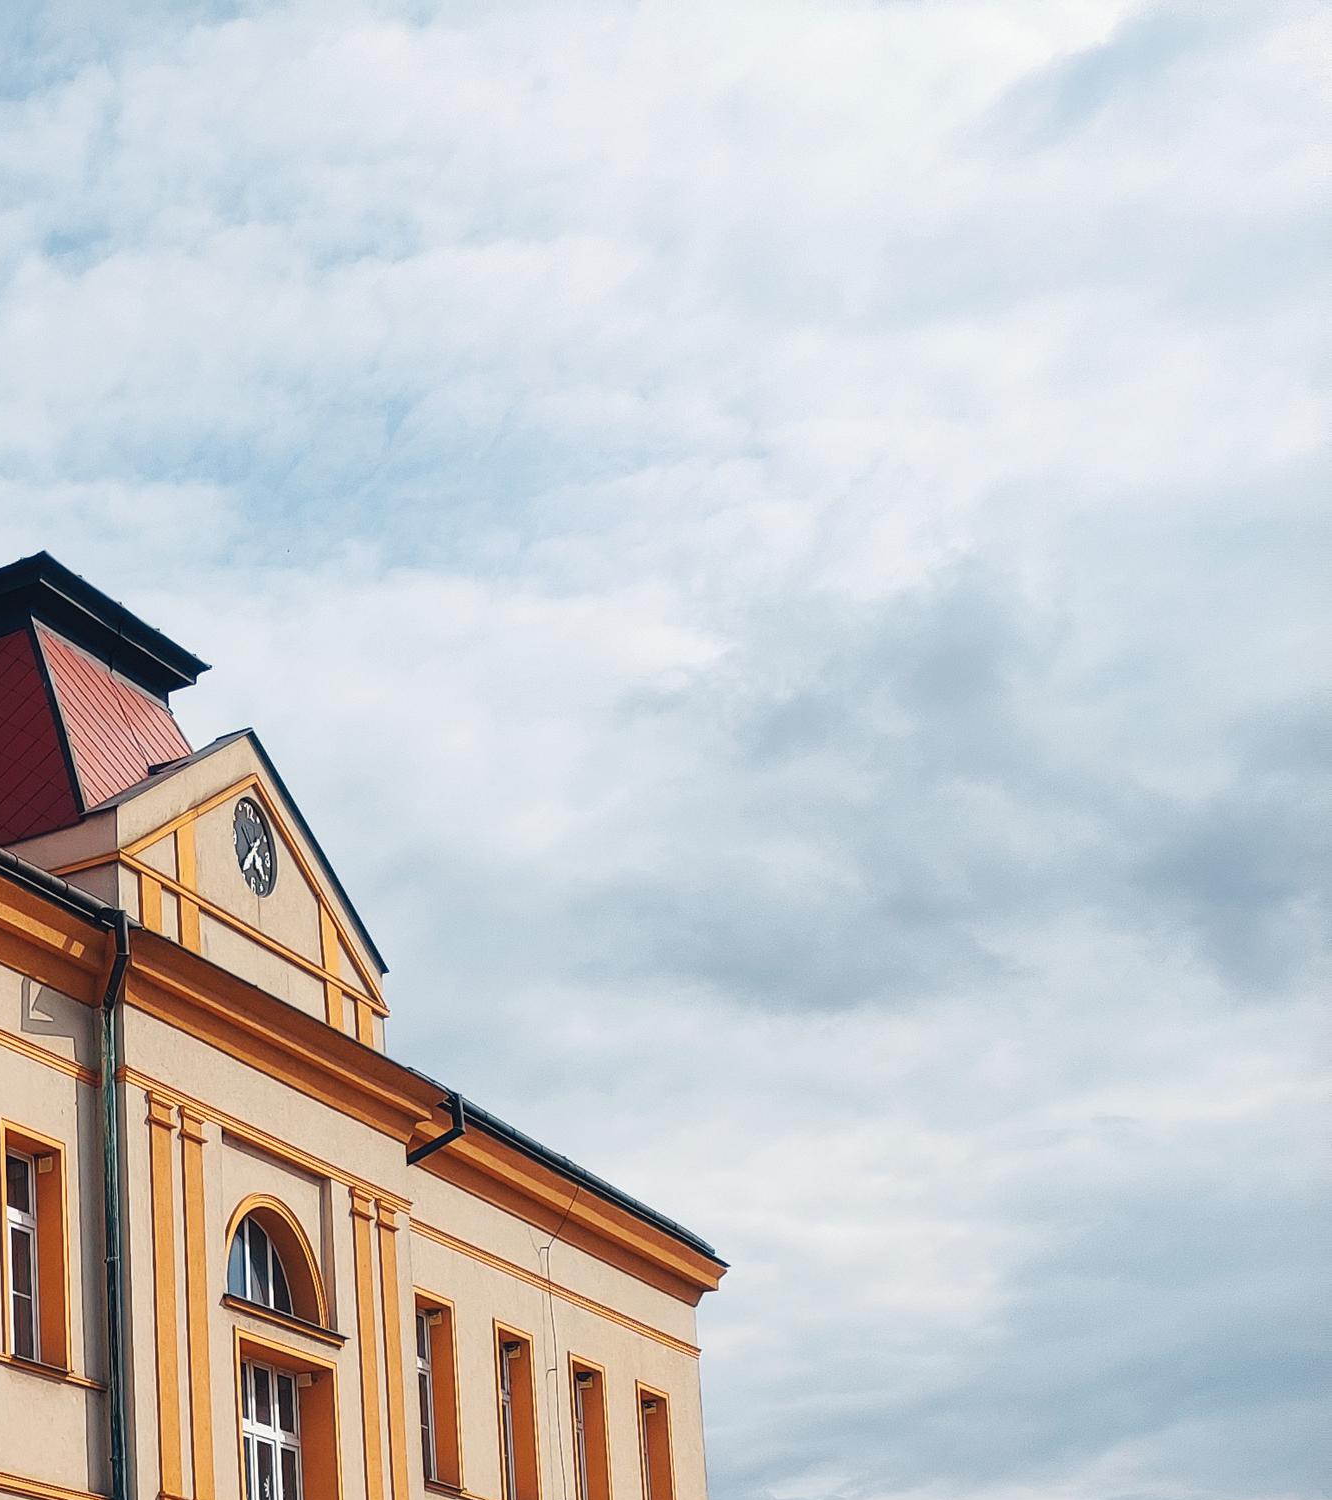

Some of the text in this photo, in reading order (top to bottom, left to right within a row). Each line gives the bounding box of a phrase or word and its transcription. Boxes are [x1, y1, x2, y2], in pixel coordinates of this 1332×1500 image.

[244, 803, 256, 823] 12
[264, 851, 271, 868] 3
[250, 876, 257, 894] 6
